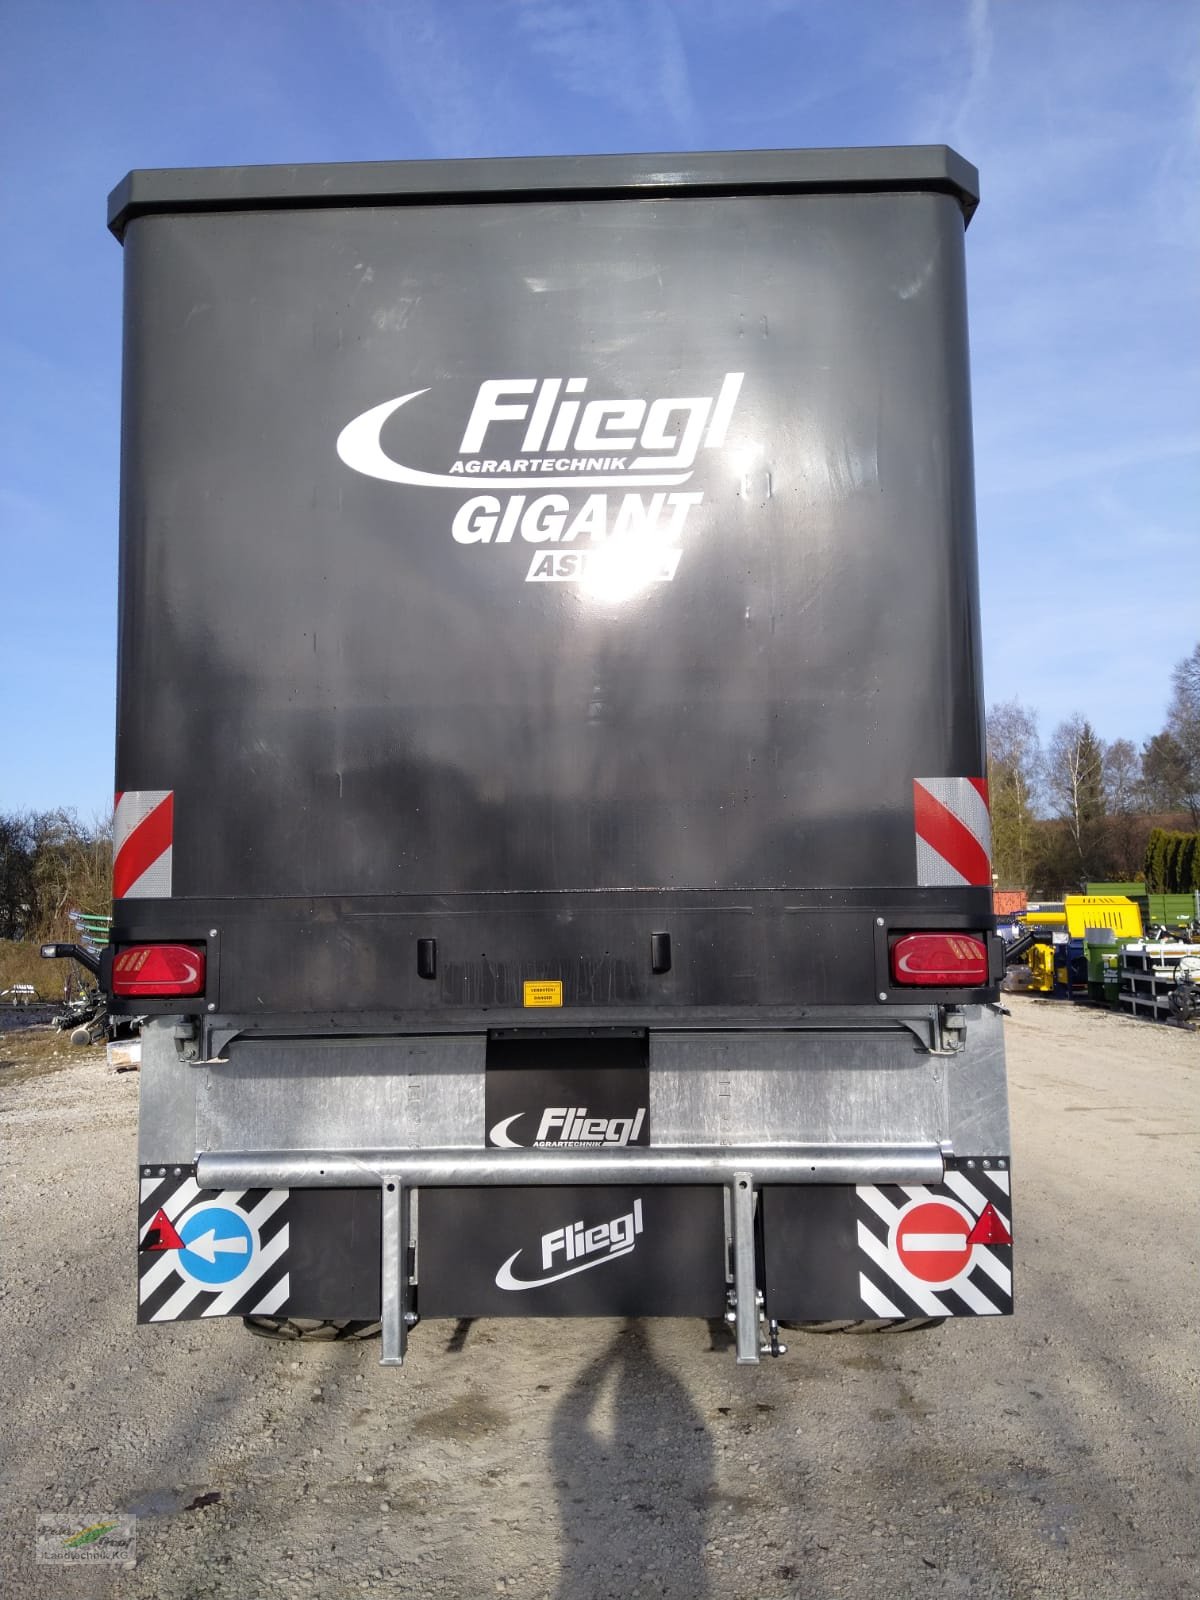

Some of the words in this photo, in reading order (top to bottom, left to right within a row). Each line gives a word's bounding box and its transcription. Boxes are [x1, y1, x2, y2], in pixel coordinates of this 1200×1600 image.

[459, 372, 745, 469] Fliegl
[449, 457, 630, 474] AGRARTECHNIK
[451, 491, 705, 545] GIGANT
[536, 1107, 647, 1147] Fliegl
[541, 1198, 644, 1271] Fliegl
